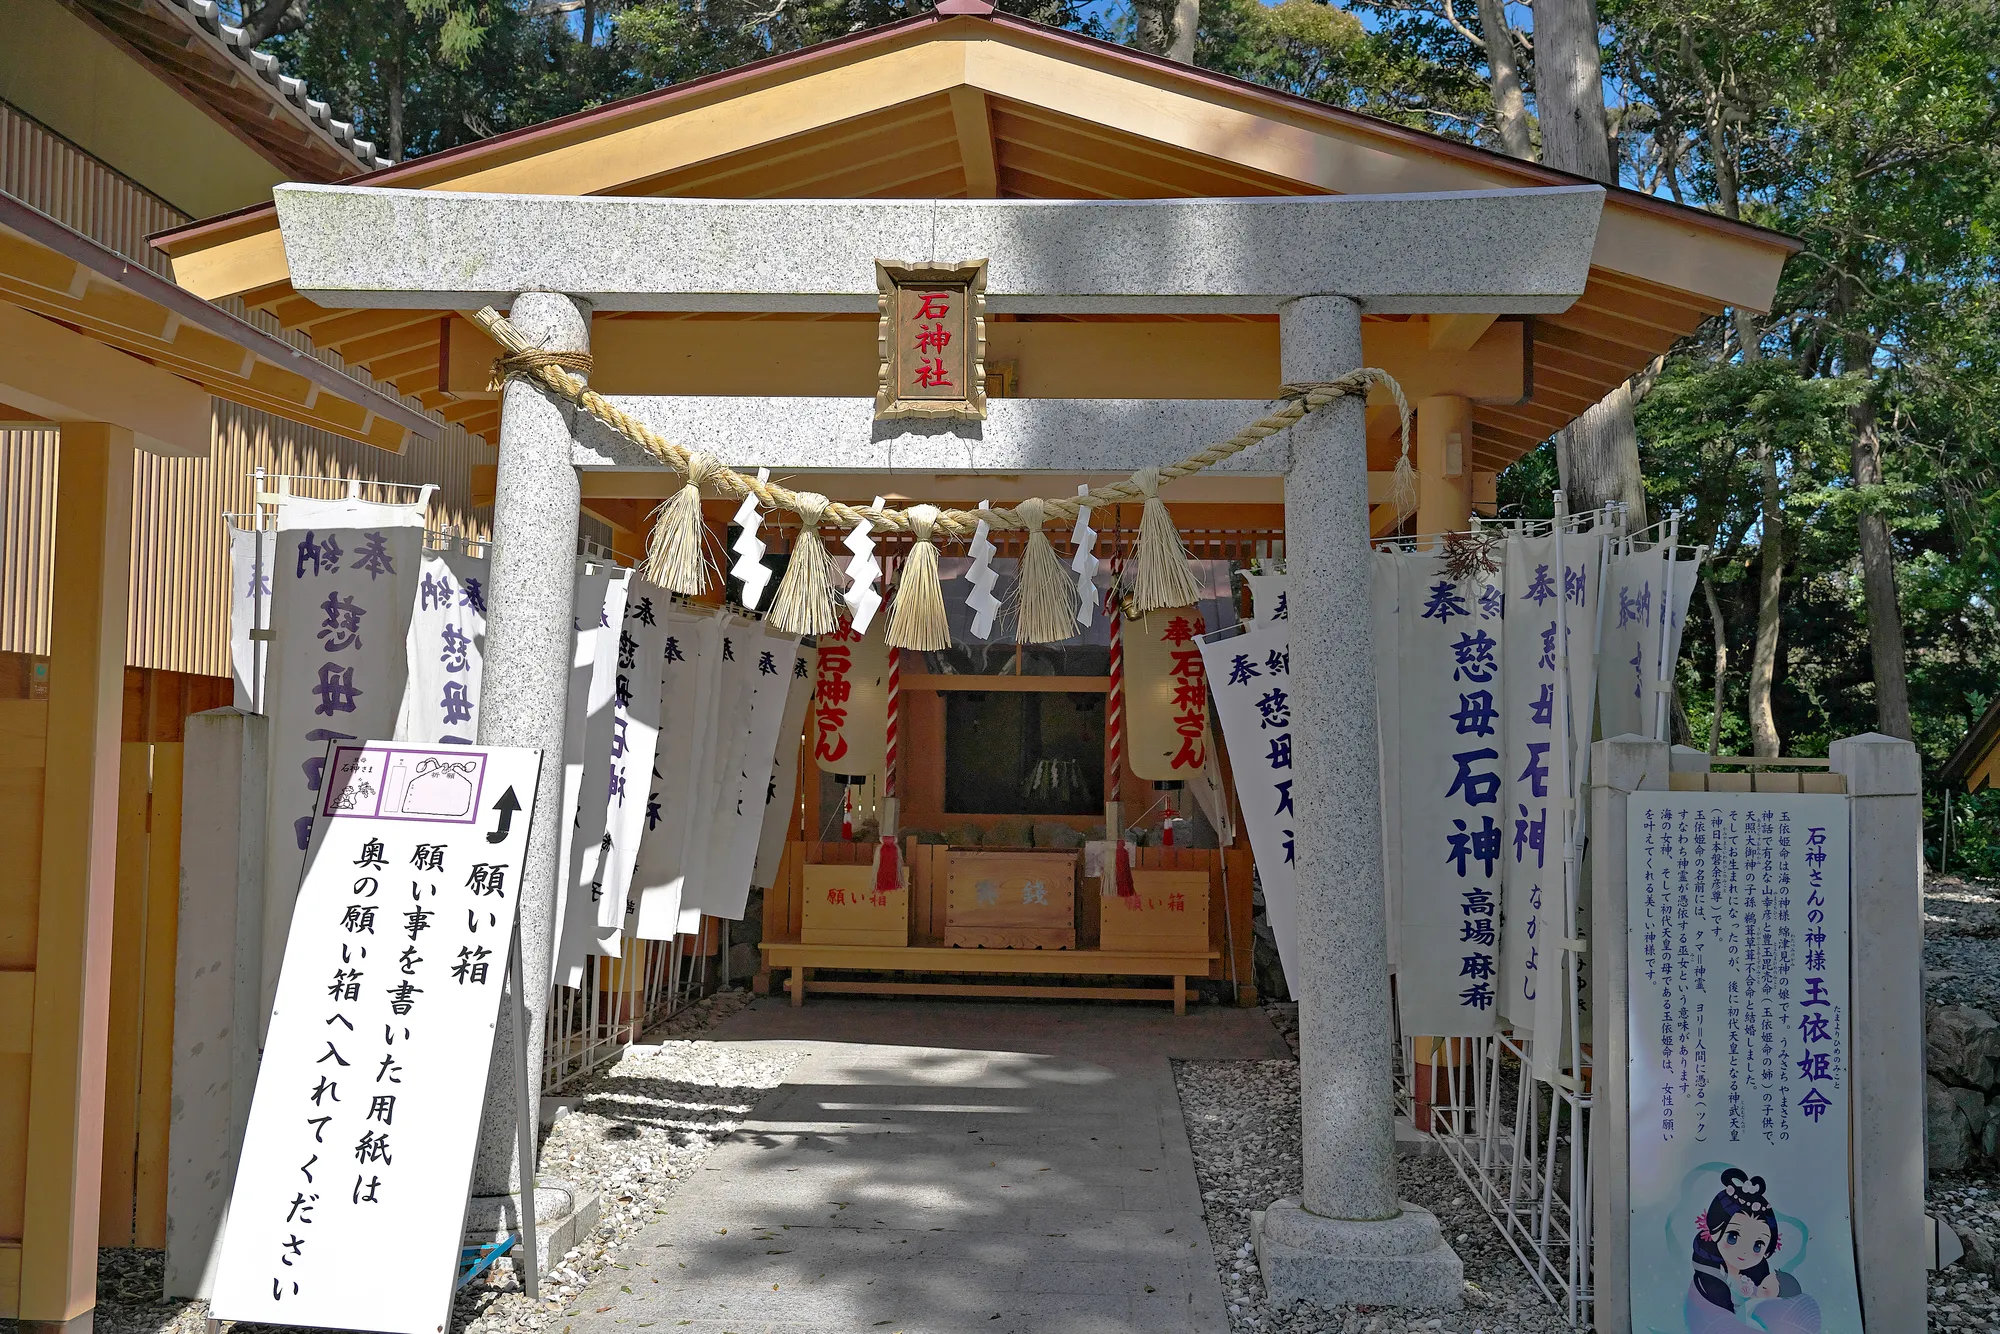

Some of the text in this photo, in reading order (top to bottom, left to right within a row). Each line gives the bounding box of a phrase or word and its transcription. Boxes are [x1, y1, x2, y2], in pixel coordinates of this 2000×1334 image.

[911, 293, 953, 389] 石神社
[814, 644, 852, 762] 石神さん
[1169, 650, 1206, 770] 石神さん
[1444, 629, 1502, 1011] 慈母石神 高場麻希
[450, 861, 509, 987] 願い箱
[1523, 884, 1542, 1002] なかよし
[1643, 808, 1657, 985] を叶えてくれる美しい神様です。
[351, 842, 449, 1206] 願い事を書いた用紙は
[1797, 826, 1833, 1123] 石神さんの神様 玉依姫命
[272, 836, 390, 1302] 奥の願い箱へ入れてください
